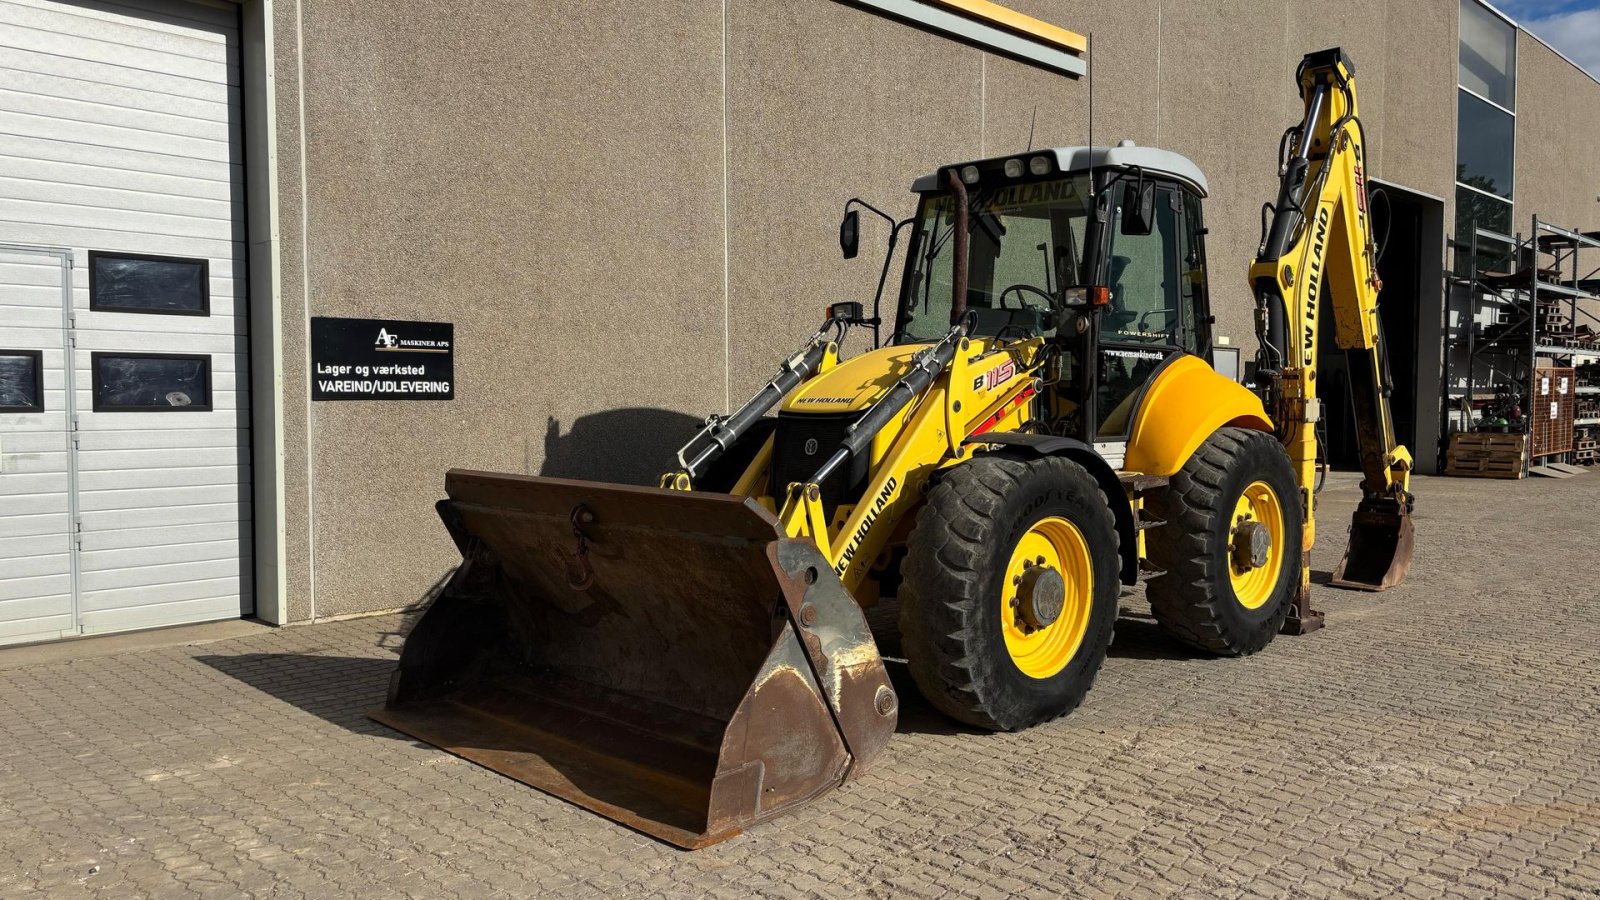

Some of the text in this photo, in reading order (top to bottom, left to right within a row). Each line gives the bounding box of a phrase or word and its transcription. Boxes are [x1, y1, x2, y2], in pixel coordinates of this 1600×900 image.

[990, 180, 1074, 207] OLLAND
[1304, 207, 1329, 366] EW HOLLAND
[1117, 330, 1170, 339] POWERSHIFT
[400, 339, 436, 347] MASKINER
[317, 362, 425, 377] Lager og værksted
[318, 379, 450, 394] VAREIND/UDLEVERING
[853, 476, 898, 546] HOLLAND
